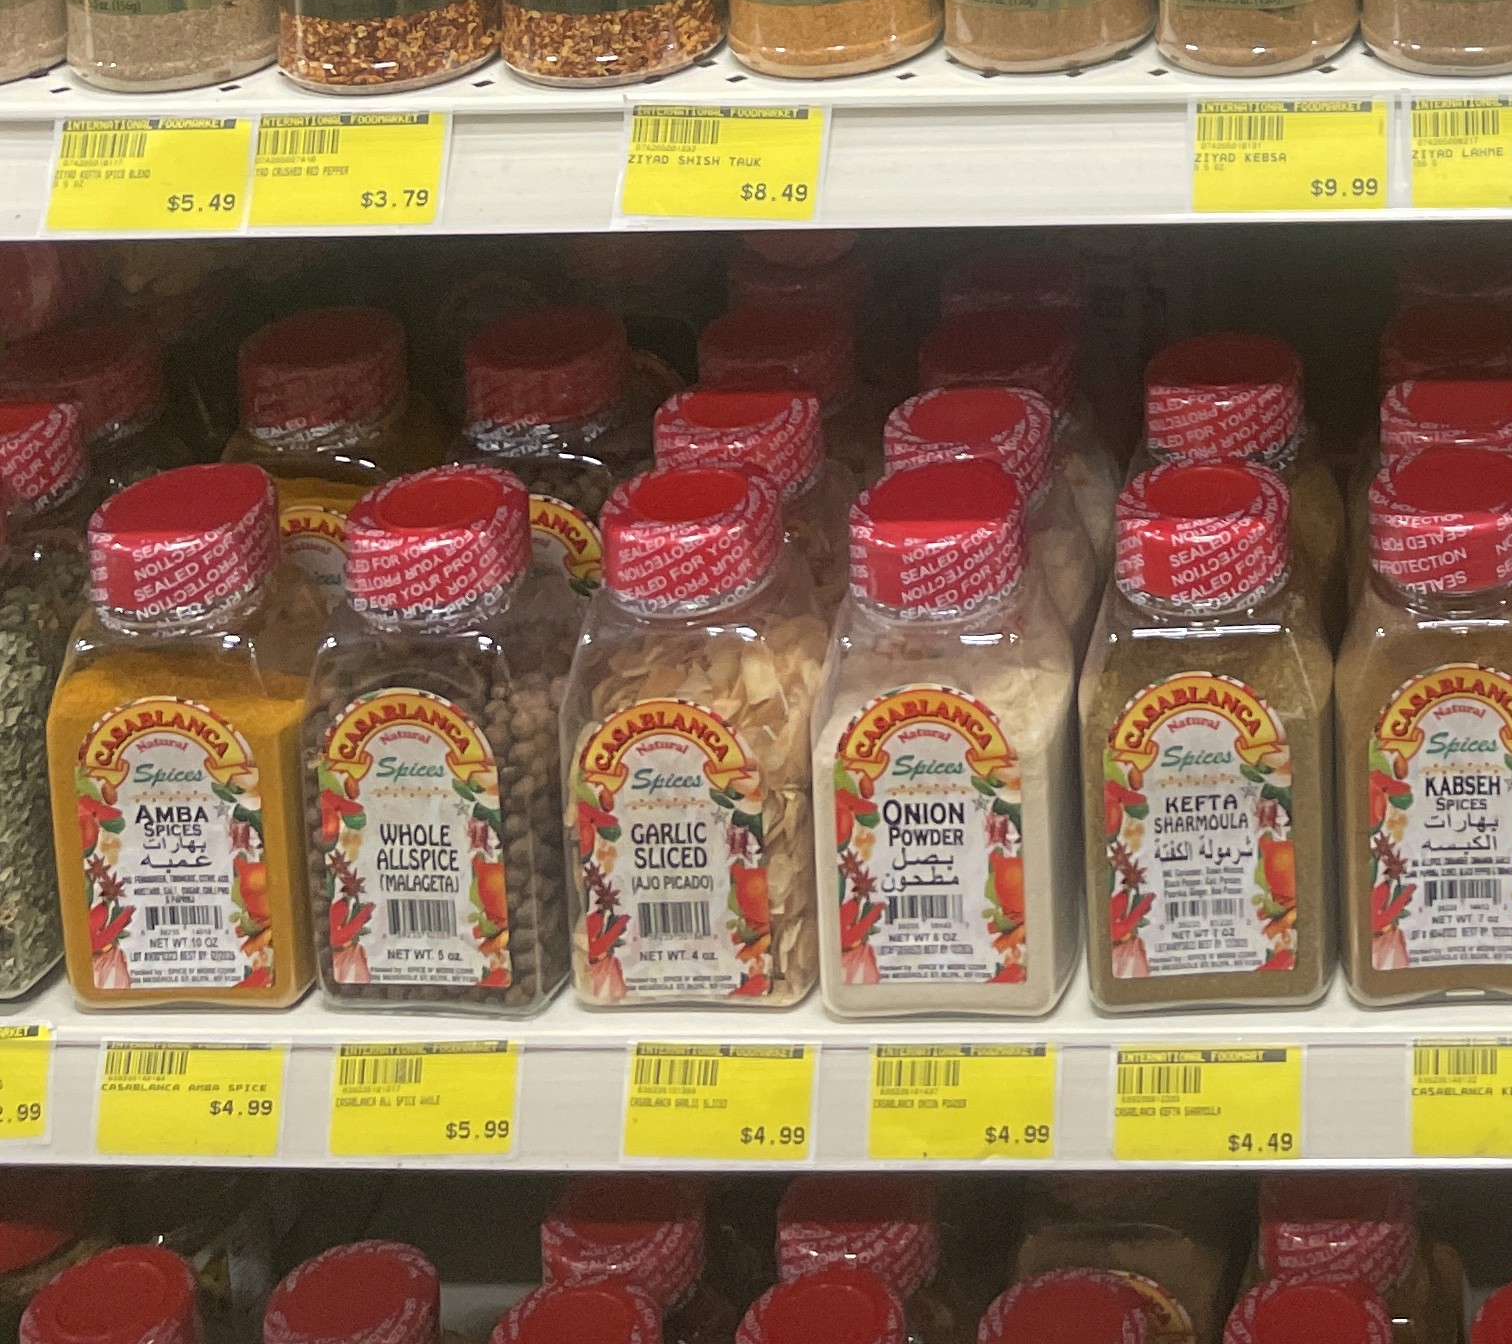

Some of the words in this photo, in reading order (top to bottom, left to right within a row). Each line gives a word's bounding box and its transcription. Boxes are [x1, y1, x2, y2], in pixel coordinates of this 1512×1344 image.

[740, 182, 808, 202] $8.49
[1310, 178, 1379, 198] $9.99
[167, 192, 236, 213] $5.49
[360, 189, 429, 209] $3.79
[94, 709, 230, 767] CASABLANCA
[132, 763, 205, 785] Spices
[1425, 776, 1501, 798] KABSEH
[882, 800, 966, 825] ONION
[1165, 794, 1240, 813] KEFTA
[1436, 797, 1488, 811] SPICES
[134, 804, 210, 825] AMBA
[1154, 813, 1250, 834] SHARMOULA
[144, 824, 203, 837] SPICES
[379, 824, 452, 848] WHOLE
[630, 822, 708, 846] GARLIC
[887, 827, 965, 846] POWDER
[376, 849, 460, 872] ALLSPICE
[633, 846, 708, 870] SLICED
[379, 872, 460, 895] (MALAGETA)
[631, 875, 660, 894] (AJO
[663, 874, 714, 892] PICADO)
[210, 1099, 273, 1117] $4.99
[445, 1120, 510, 1140] $5.99
[740, 1126, 805, 1146] $4.99
[984, 1125, 1050, 1145] $4.99
[1228, 1133, 1294, 1153] $4.49
